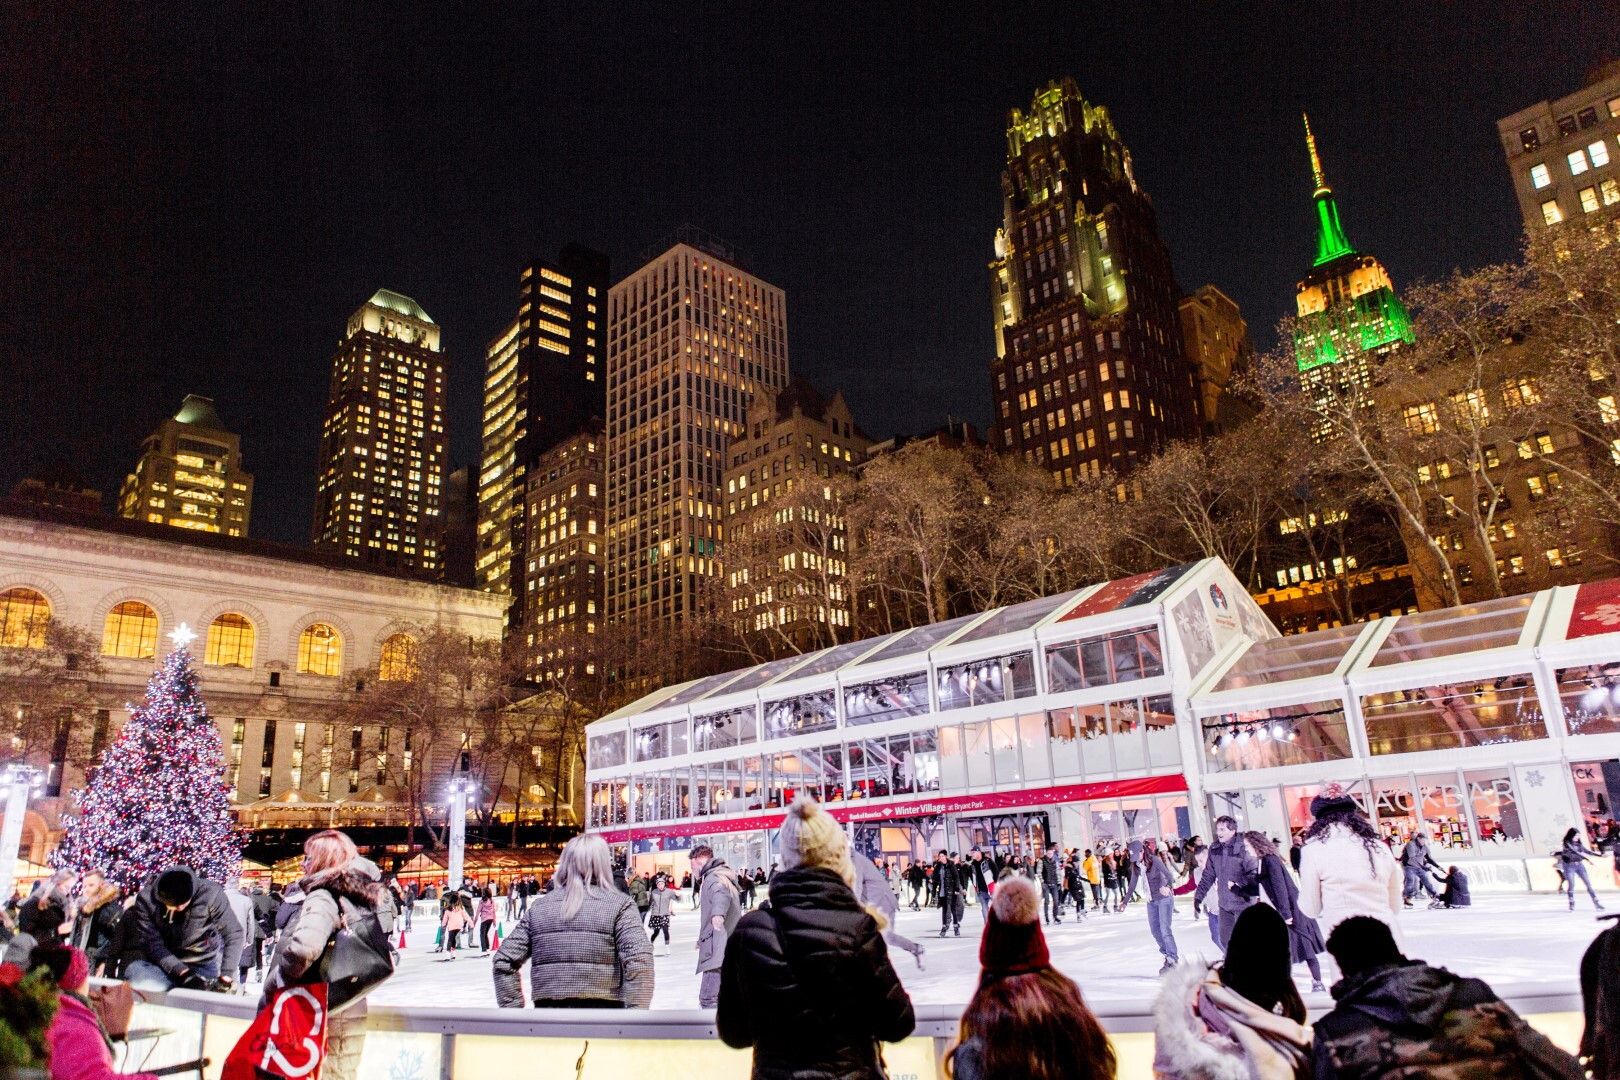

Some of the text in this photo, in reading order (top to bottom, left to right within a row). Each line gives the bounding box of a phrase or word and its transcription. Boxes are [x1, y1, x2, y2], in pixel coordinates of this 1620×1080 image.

[1573, 768, 1595, 779] CK
[895, 806, 920, 816] Winter
[920, 803, 946, 814] Village
[954, 803, 971, 811] Bryant
[971, 801, 983, 809] Park
